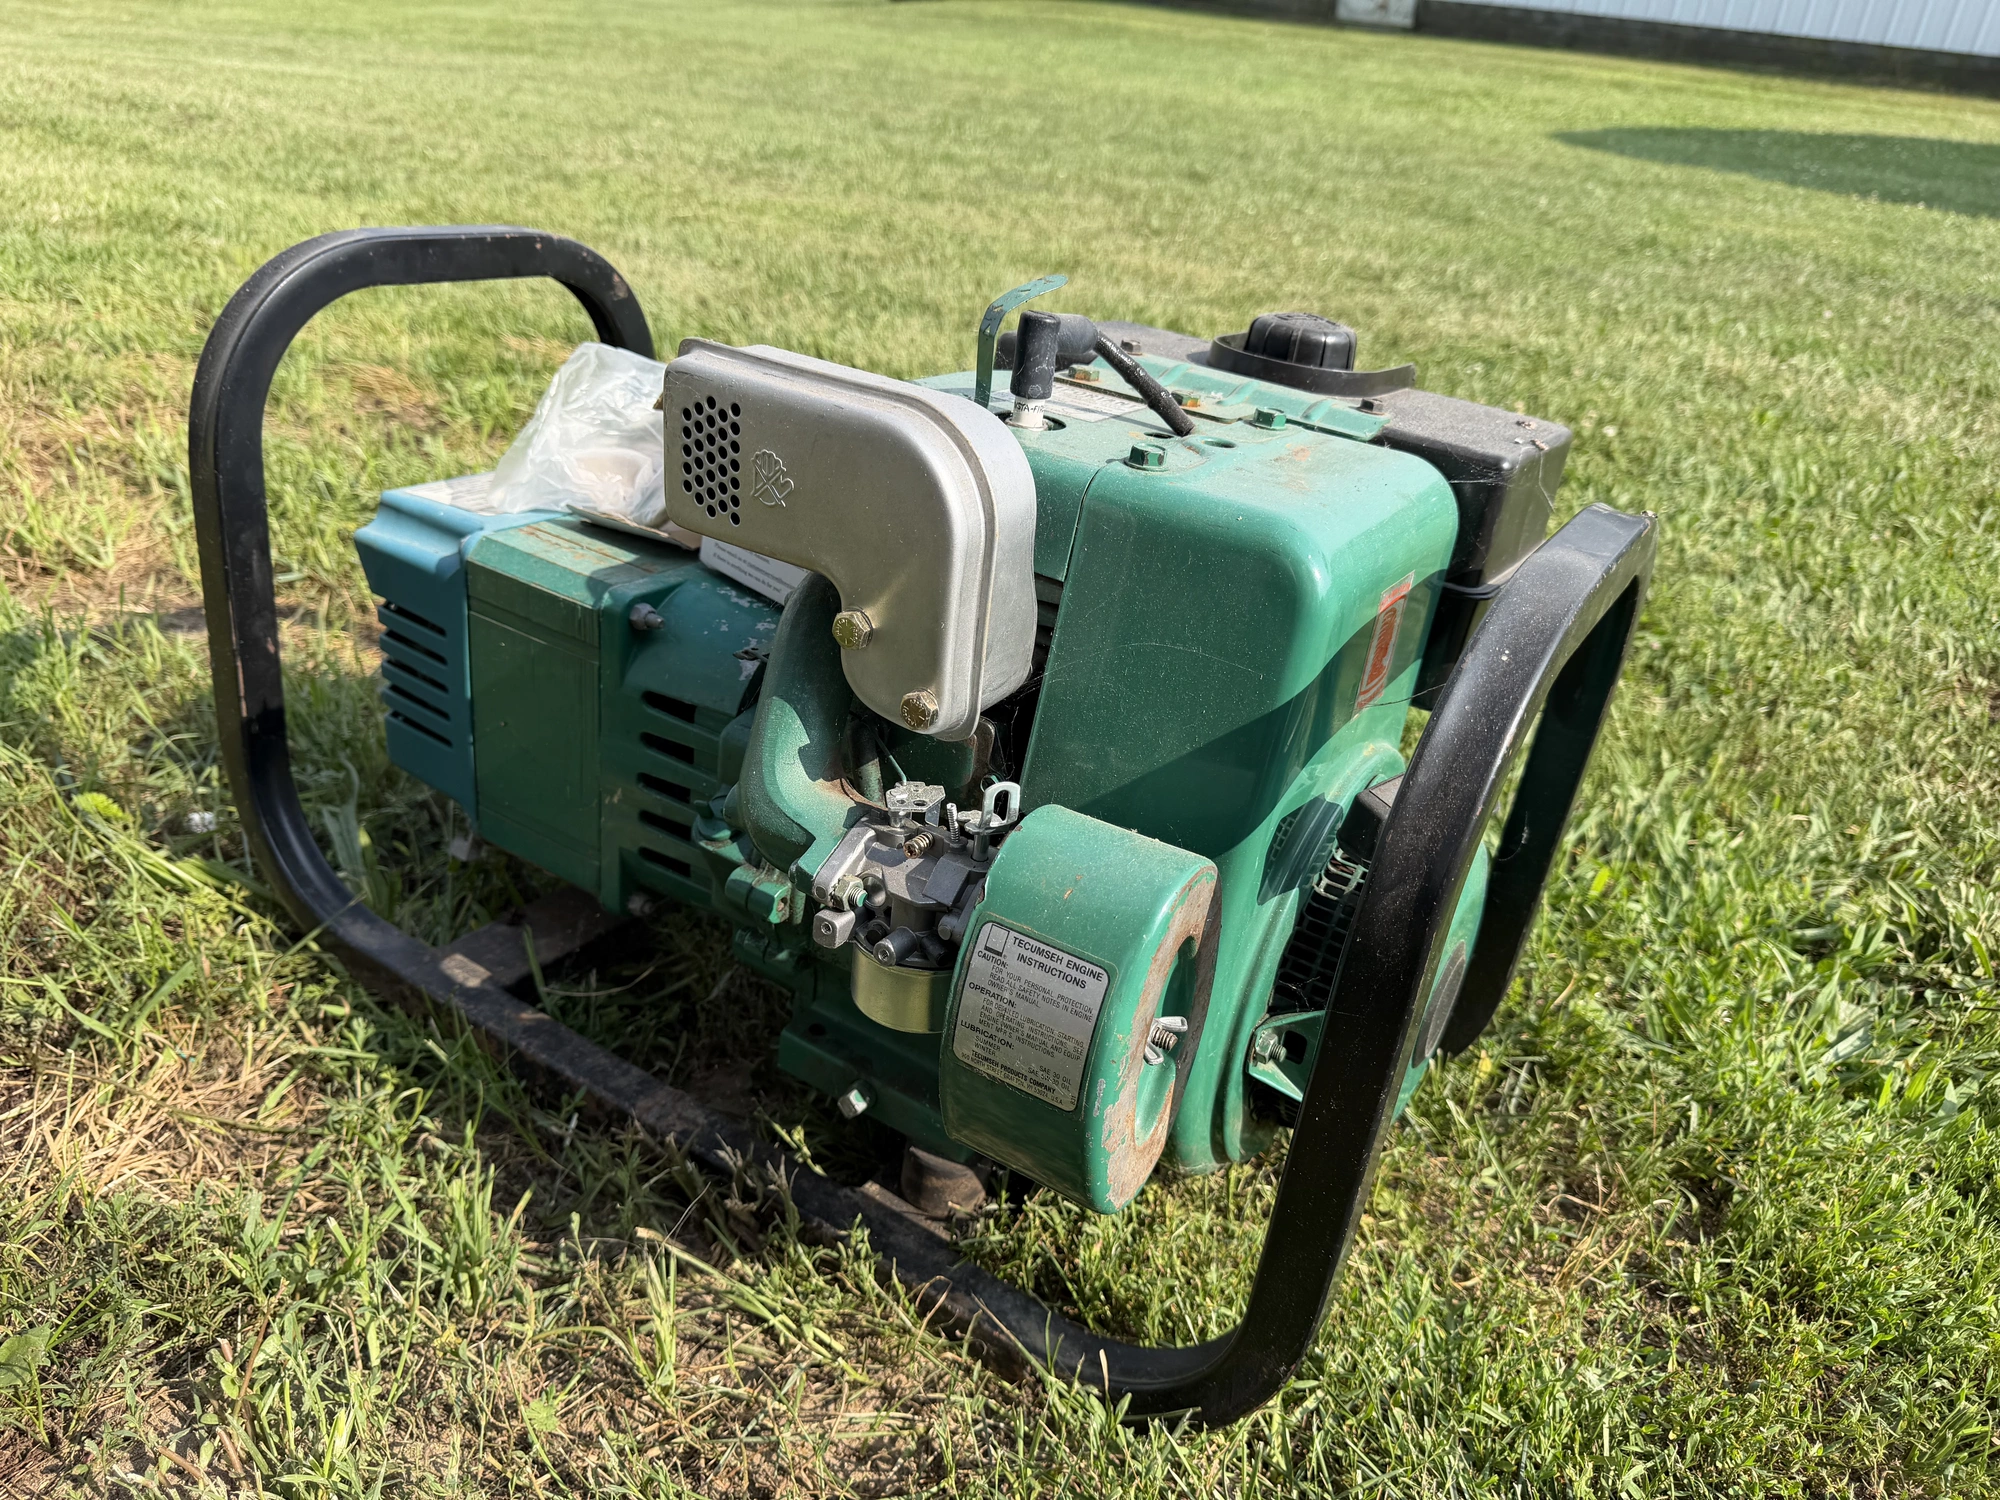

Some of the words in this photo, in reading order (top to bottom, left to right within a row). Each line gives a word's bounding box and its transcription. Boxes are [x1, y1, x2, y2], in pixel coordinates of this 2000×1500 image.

[977, 950, 1008, 969] CAUTION:
[1013, 936, 1064, 965] TECUMSEH
[1066, 959, 1104, 982] ENGINE
[1017, 953, 1087, 989] INSTRUCTIONS
[968, 981, 1017, 1009] OPERATION:
[987, 979, 1014, 996] OWNER'S
[990, 972, 1005, 984] READ
[1005, 980, 1017, 989] ALL
[1018, 985, 1041, 999] SAFETY
[1042, 994, 1061, 1009] NOTES
[1062, 1004, 1069, 1012] IN
[1070, 1008, 1093, 1023] ENGINE
[992, 965, 1004, 974] FOR
[1006, 971, 1022, 983] YOUR
[1024, 979, 1054, 998] PERSONAL
[982, 997, 994, 1006] FOR
[960, 1019, 1015, 1050] LUBRICATION:
[978, 1018, 994, 1030] MENT
[979, 1011, 999, 1026] ENGINE
[1025, 1033, 1049, 1048] MANUAL
[1050, 1044, 1062, 1054] AND
[981, 1005, 993, 1014] AND
[995, 1011, 1025, 1029] OPERATING
[1072, 1046, 1084, 1056] SEE
[970, 1057, 986, 1067] NORTH
[986, 1064, 1003, 1076] STREET
[971, 1049, 999, 1067] TECUMSEH
[1000, 1063, 1028, 1082] PRODUCTS
[1029, 1077, 1056, 1095] COMPANY
[974, 1042, 996, 1056] WINTER
[1027, 1067, 1039, 1077] SAE
[1061, 1082, 1071, 1092] OIL
[975, 1035, 1001, 1051] SUMMER
[1039, 1065, 1052, 1075] SAE
[1052, 1071, 1061, 1080] 30
[1062, 1076, 1072, 1086] OIL
